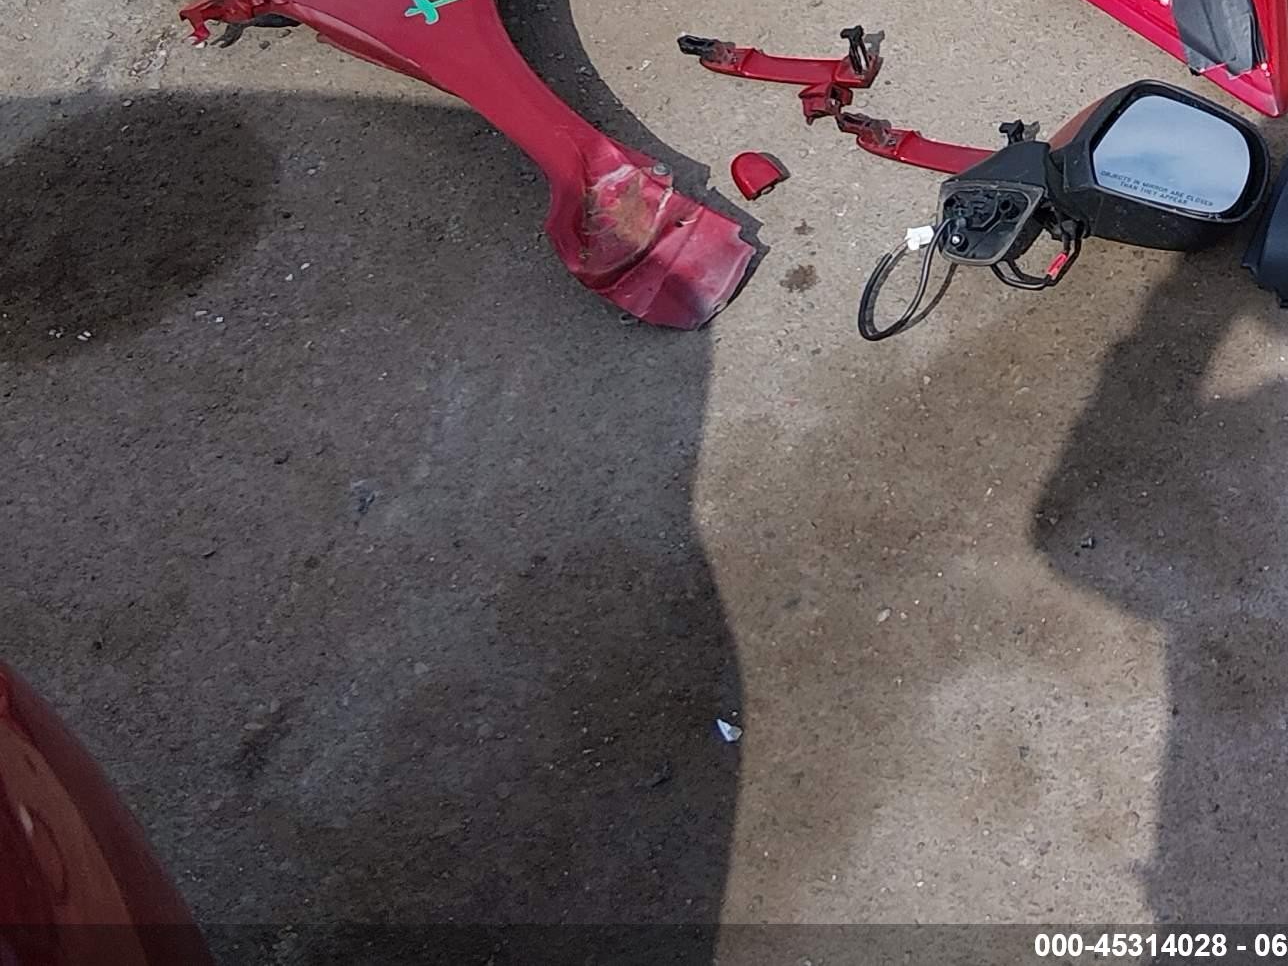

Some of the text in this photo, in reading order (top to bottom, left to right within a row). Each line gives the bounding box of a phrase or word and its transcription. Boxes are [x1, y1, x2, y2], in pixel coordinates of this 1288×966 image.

[1100, 170, 1131, 183] OBJECTS
[1142, 181, 1168, 193] MIRROR
[1171, 190, 1184, 198] ARE
[1187, 193, 1214, 207] CLOSER
[1120, 181, 1188, 205] THAN THEY APPEAR
